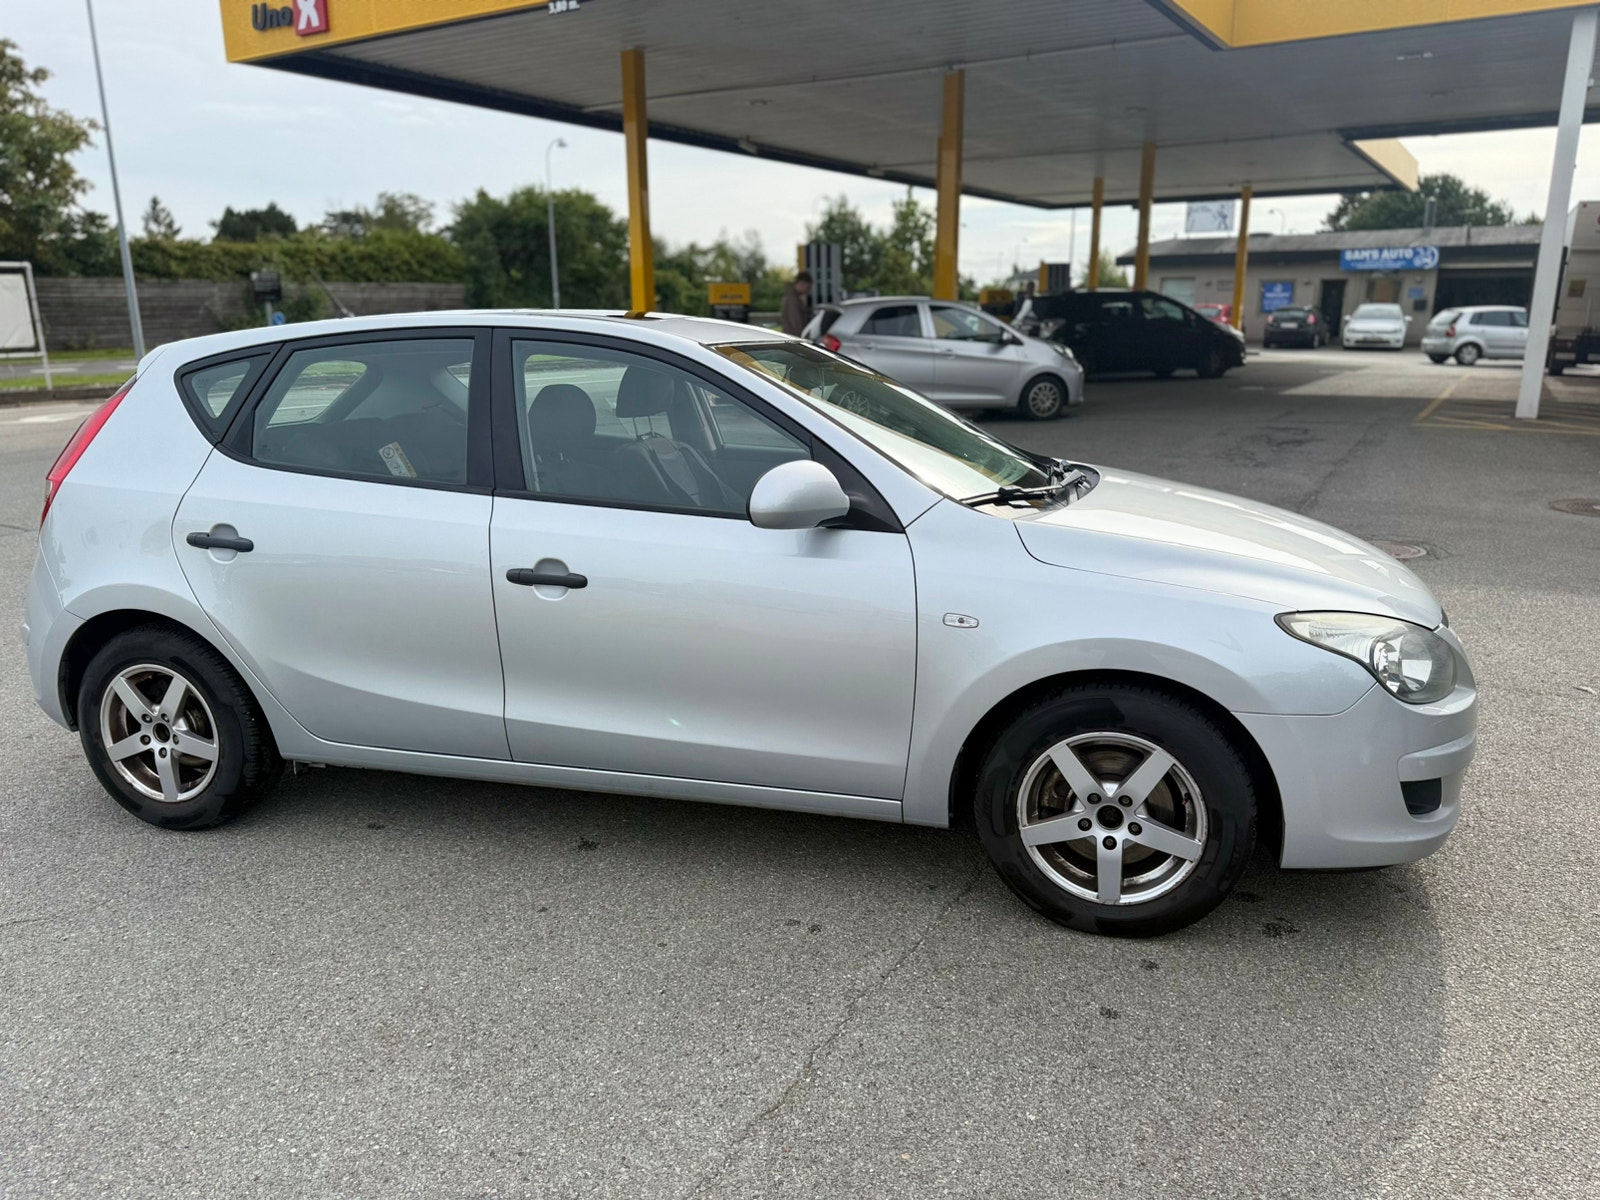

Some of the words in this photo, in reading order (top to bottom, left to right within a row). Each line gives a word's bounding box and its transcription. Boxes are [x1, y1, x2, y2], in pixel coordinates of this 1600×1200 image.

[251, 3, 293, 32] Uno
[297, 0, 320, 31] X
[1381, 248, 1414, 260] AUTO
